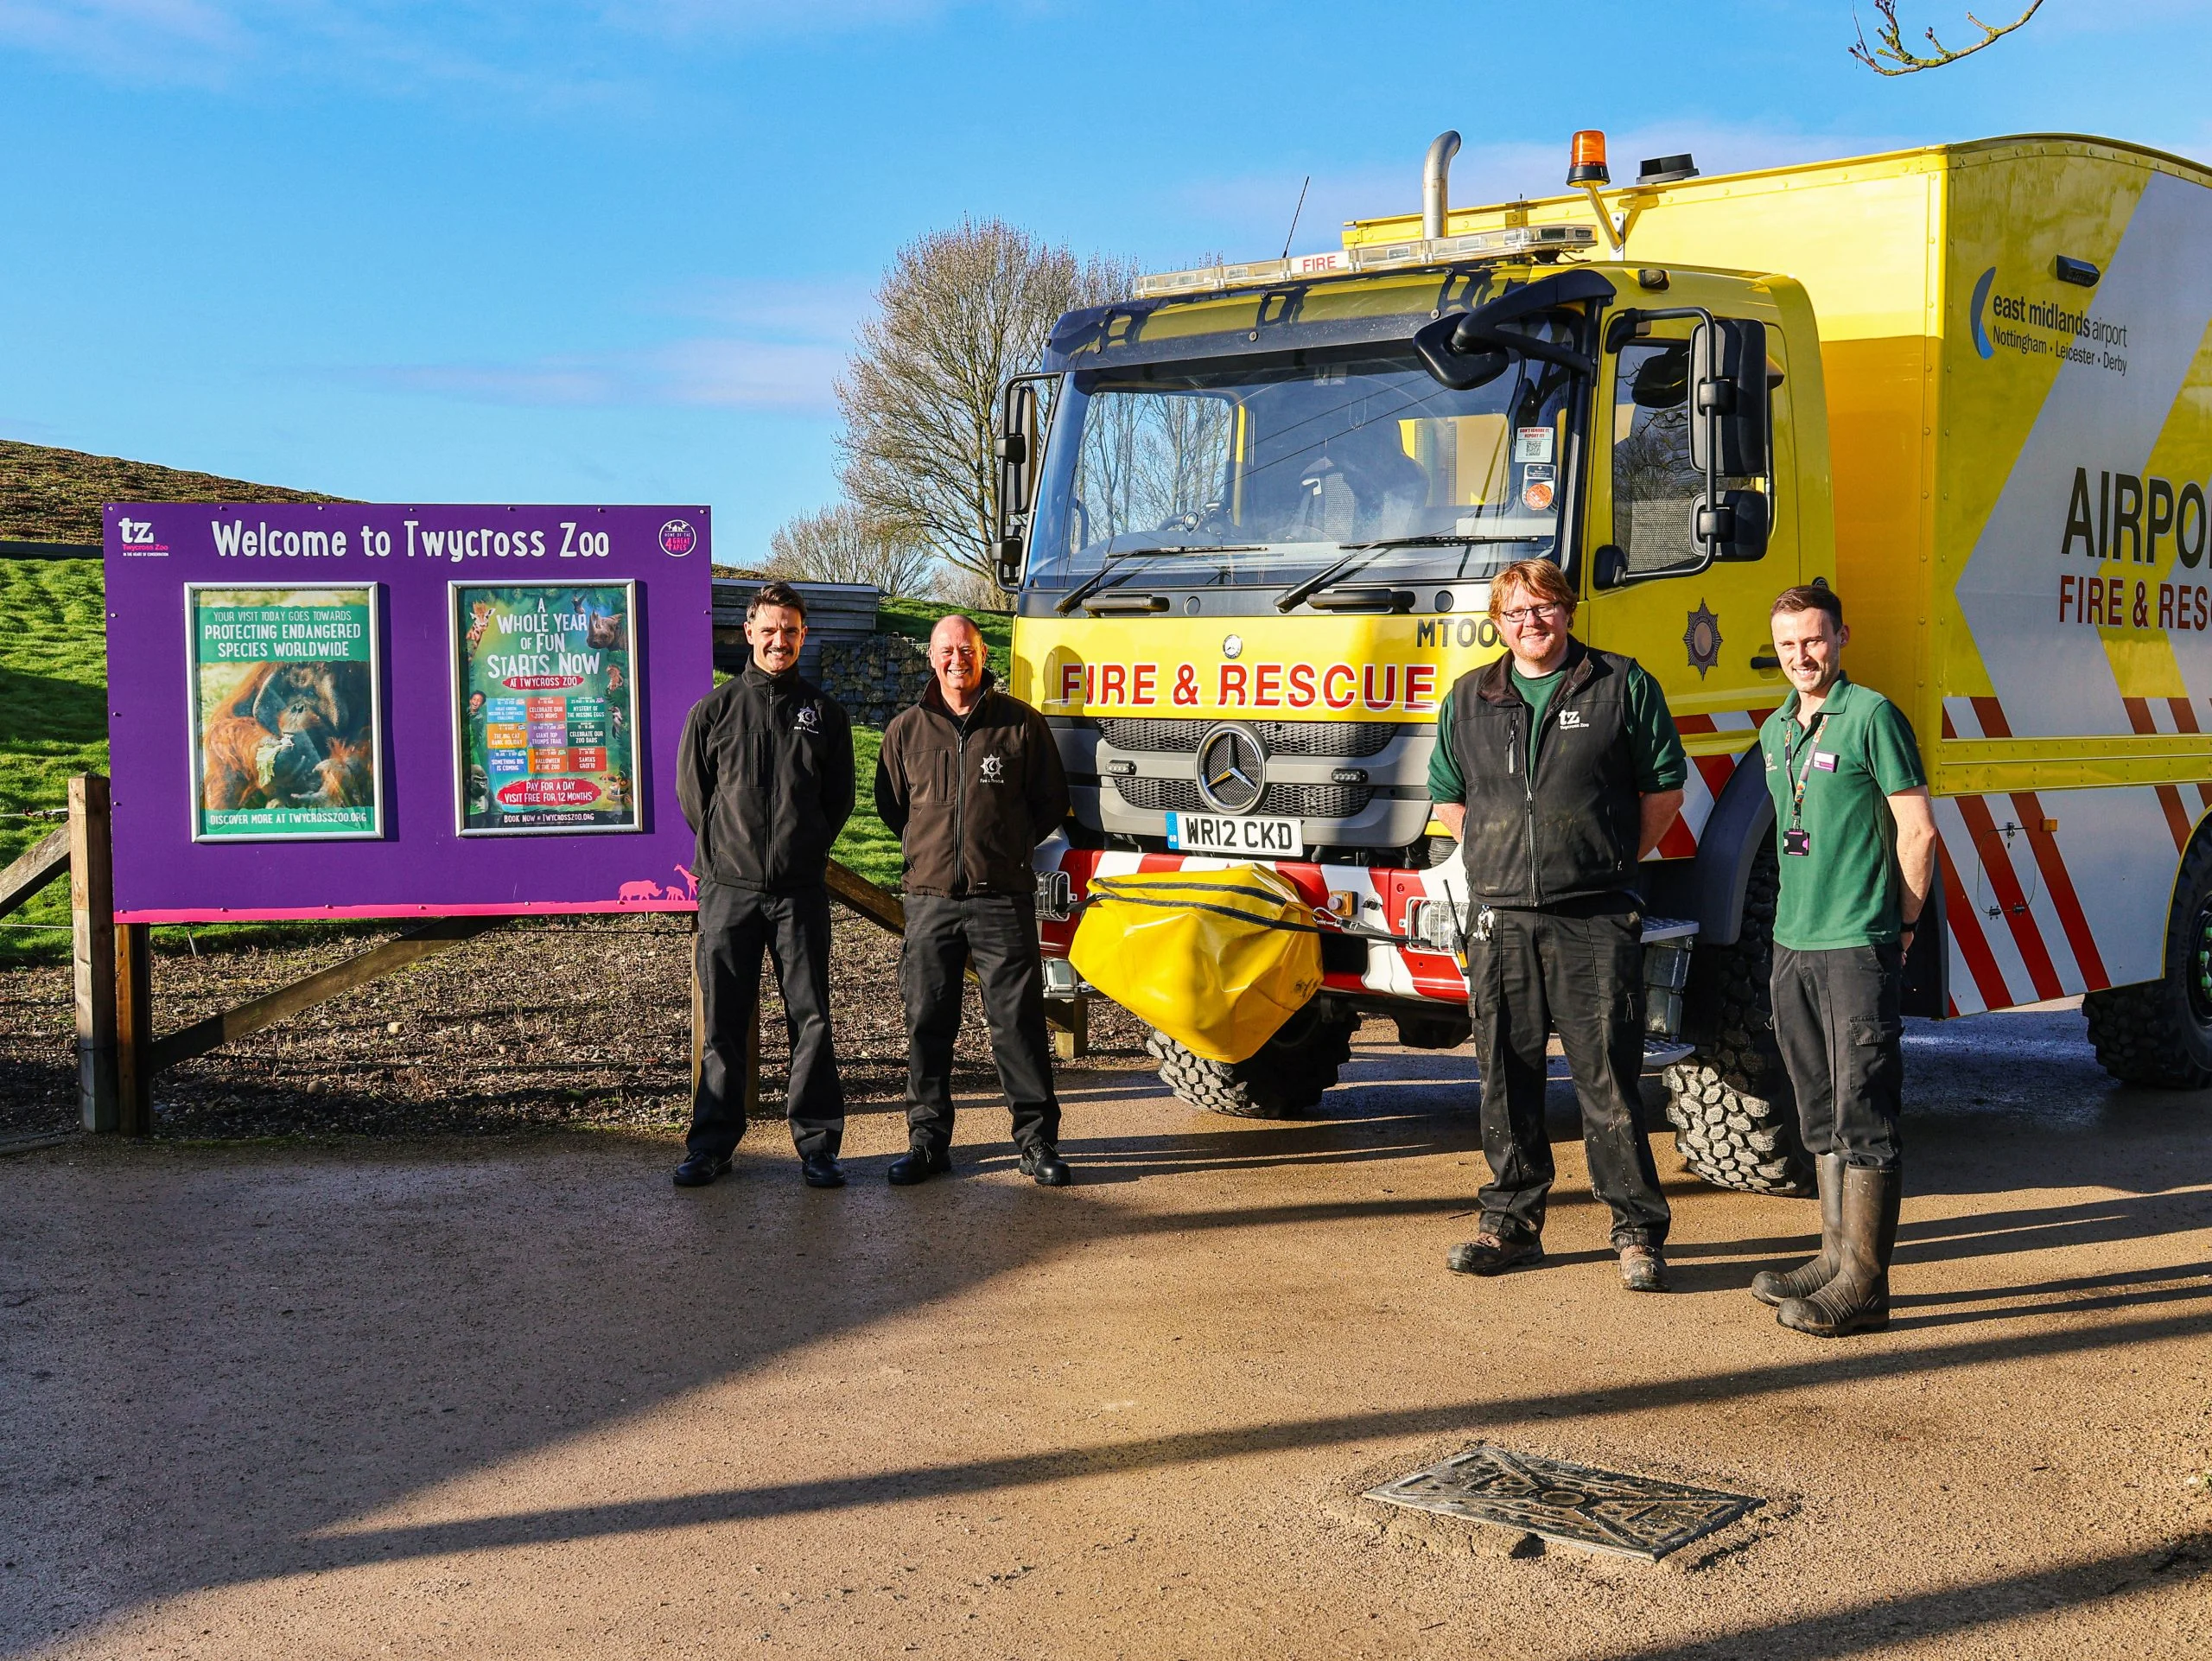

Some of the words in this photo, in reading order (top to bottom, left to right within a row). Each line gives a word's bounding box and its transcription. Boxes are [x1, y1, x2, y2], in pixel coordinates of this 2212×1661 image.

[1303, 255, 1337, 273] FIRE
[1993, 295, 2025, 322] east
[2029, 300, 2090, 338] midlands
[2092, 316, 2127, 348] airport
[1993, 325, 2047, 355] Nottingham
[2056, 340, 2095, 366] Leicester
[2103, 352, 2127, 377] Derby
[2061, 467, 2212, 570] AIRPO
[118, 517, 155, 544] tz
[212, 520, 346, 557] Welcome
[360, 525, 391, 557] to
[404, 520, 546, 563] Twycross
[560, 522, 610, 557] Zoo
[665, 538, 672, 551] 4
[537, 597, 546, 614] A
[2059, 575, 2124, 626] FIRE
[2133, 581, 2149, 627] &
[2158, 583, 2212, 632] RES
[213, 611, 235, 622] YOUR
[238, 611, 258, 622] VISIT
[261, 611, 285, 622] TODAY
[289, 610, 310, 621] GOES
[314, 610, 352, 621] TOWARDS
[496, 614, 550, 634] WHOLE
[553, 613, 588, 632] YEAR
[205, 624, 277, 640] PROTECTING
[282, 623, 361, 640] ENDANGERED
[218, 642, 268, 658] SPECIES
[273, 641, 349, 657] WORLDWIDE
[520, 637, 532, 650] OF
[537, 633, 566, 653] FUN
[486, 653, 550, 678] STARTS
[558, 652, 601, 677] NOW
[509, 678, 518, 688] AT
[520, 677, 560, 688] TWYCROSS
[563, 676, 577, 686] ZOO
[1060, 663, 1158, 706] FIRE
[1172, 663, 1199, 706] &
[1217, 663, 1437, 711] RESCUE
[1559, 710, 1580, 726] tz
[526, 782, 539, 792] PAY
[541, 781, 554, 792] FOR
[556, 781, 562, 791] A
[563, 781, 575, 791] DAY
[504, 793, 522, 804] VISIT
[524, 792, 540, 803] FREE
[543, 792, 556, 802] FOR
[557, 792, 566, 802] 12
[210, 814, 248, 825] DISCOVER
[251, 813, 274, 824] MORE
[276, 813, 286, 824] AT
[289, 812, 367, 824] TWYCROSSZOO.ORG
[504, 815, 520, 824] BOOK
[543, 813, 594, 822] TWYCROSSZOO.ORG
[1168, 834, 1178, 843] GB
[1185, 817, 1236, 847] WR12
[1243, 821, 1293, 850] CKD
